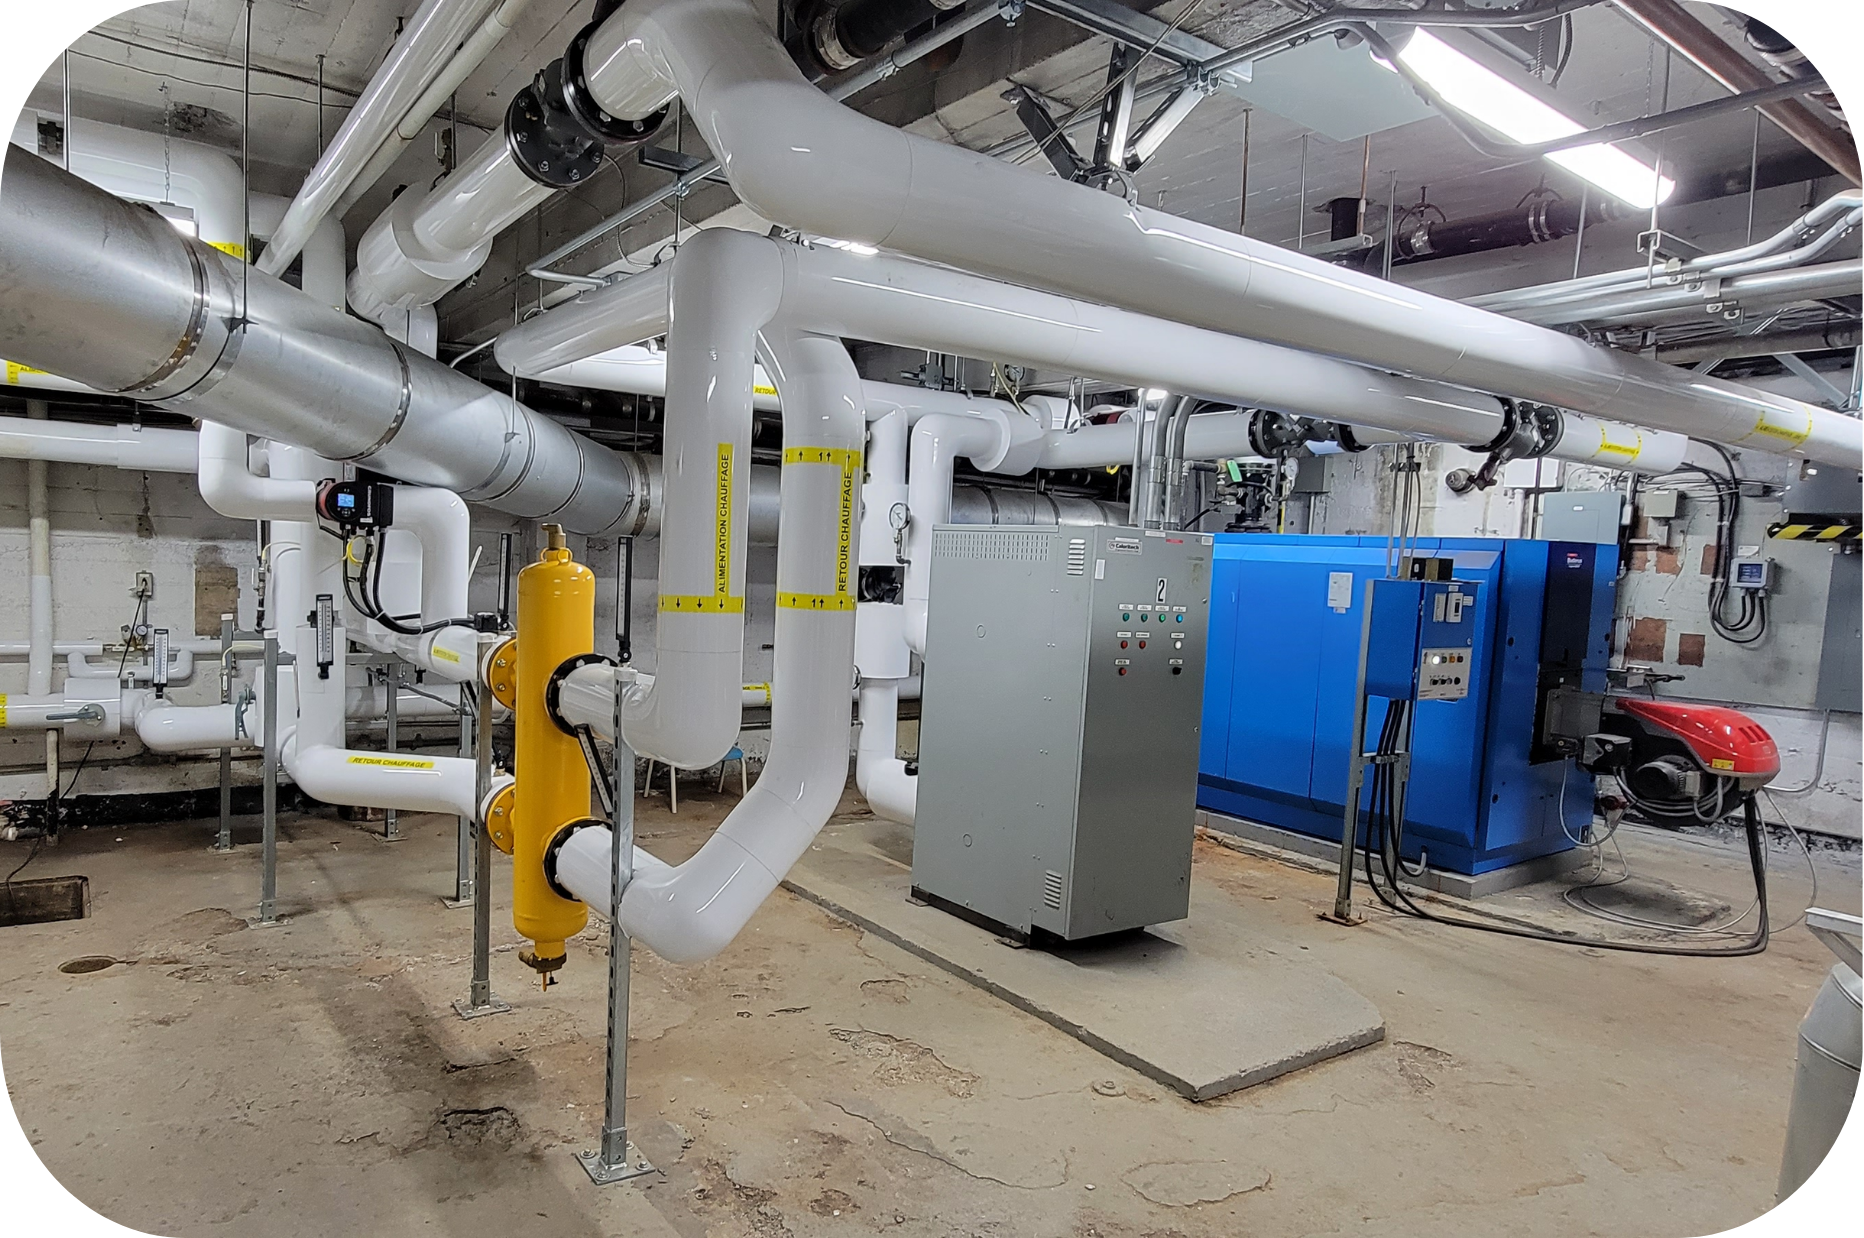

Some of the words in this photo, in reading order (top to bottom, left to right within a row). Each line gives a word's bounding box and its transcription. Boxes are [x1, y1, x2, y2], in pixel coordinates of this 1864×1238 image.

[755, 387, 776, 395] RETOUR
[719, 454, 729, 517] CHAUFFAGE
[840, 472, 852, 542] CHAUFFAGE
[718, 519, 727, 593] ALIMENTATION
[838, 545, 848, 592] RETOUR
[1157, 579, 1165, 602] 2
[352, 757, 381, 765] RETOUR
[382, 759, 426, 768] CHAUFFAGE
